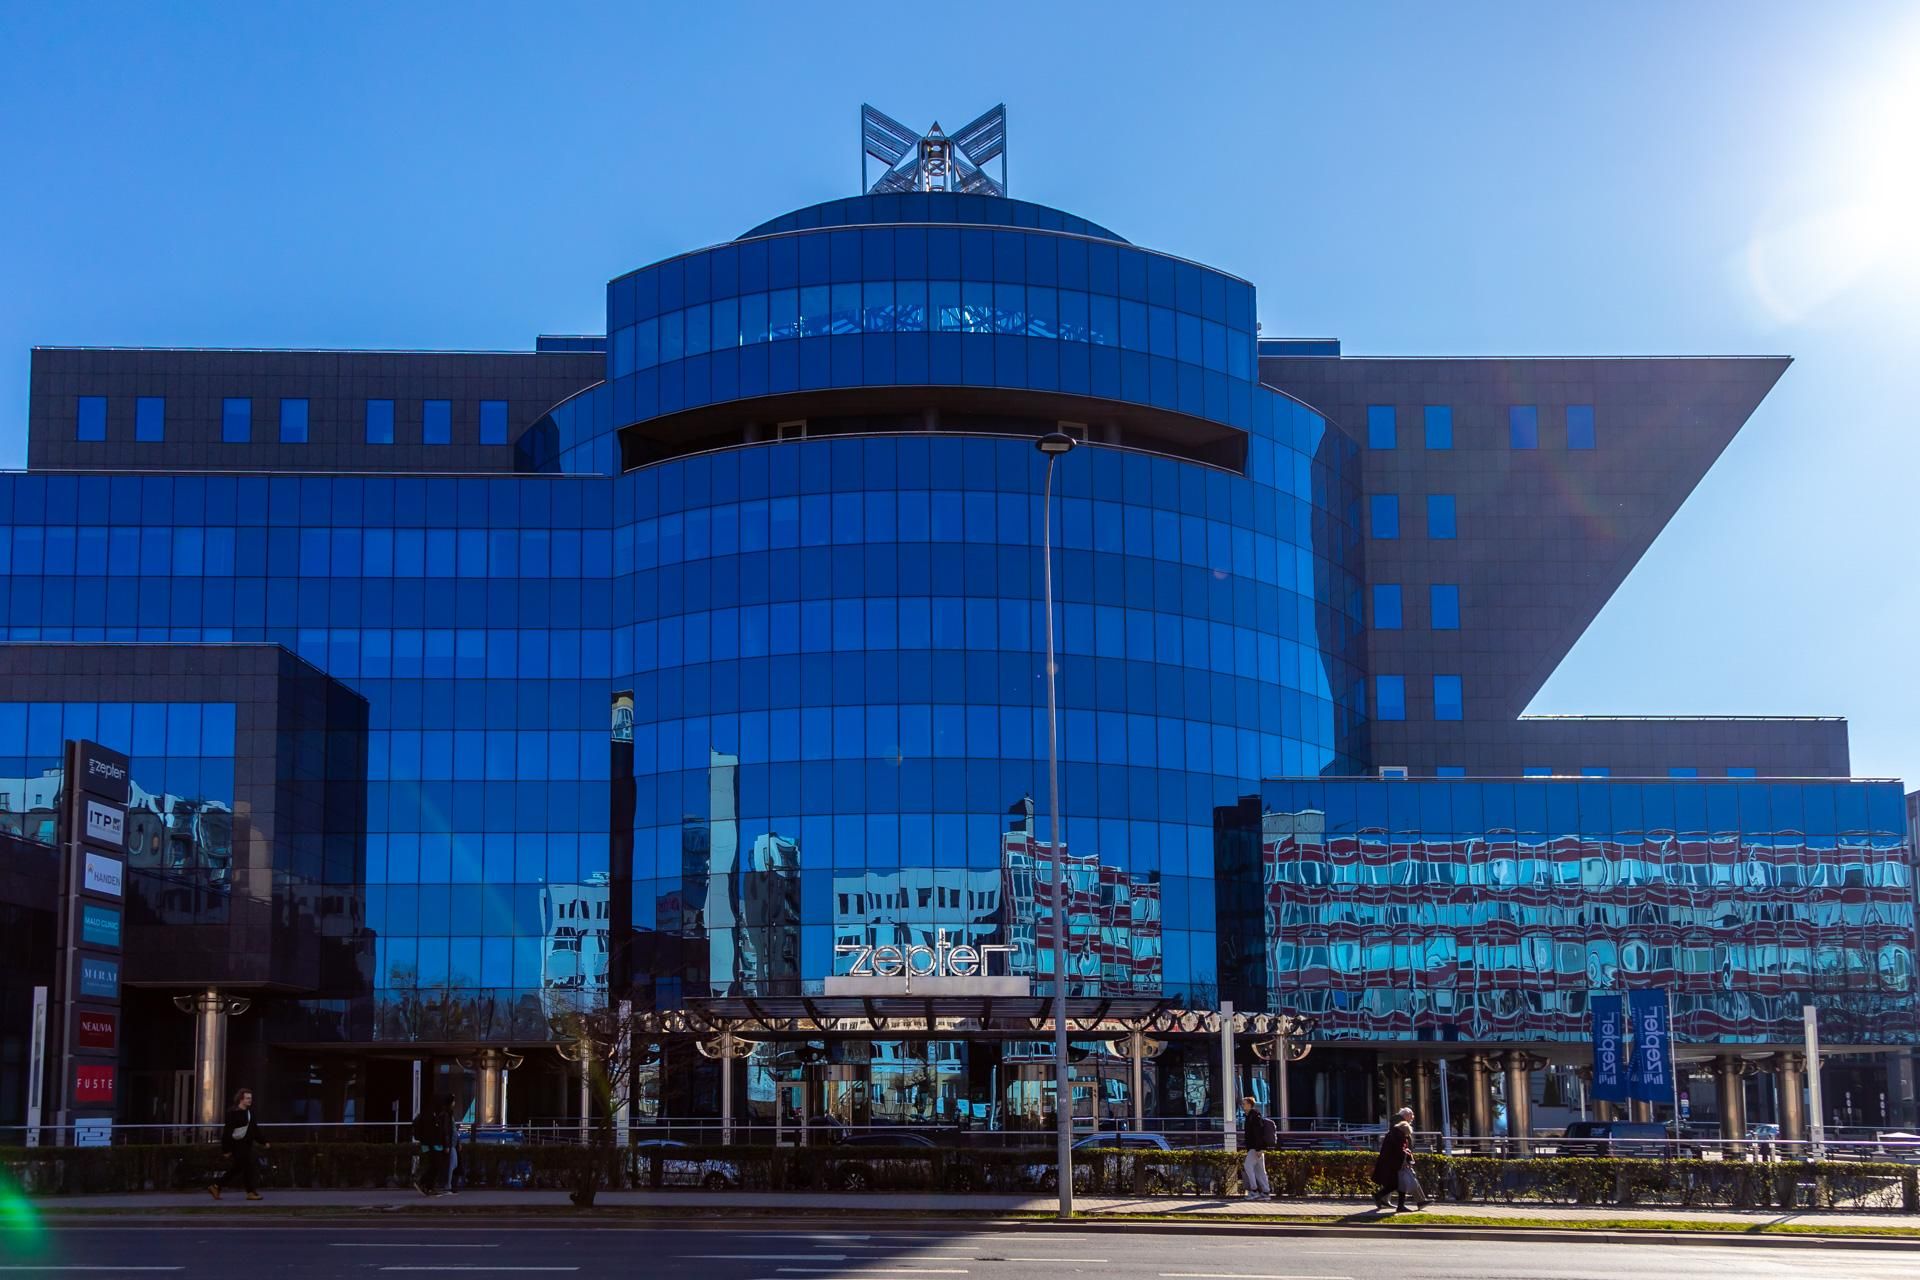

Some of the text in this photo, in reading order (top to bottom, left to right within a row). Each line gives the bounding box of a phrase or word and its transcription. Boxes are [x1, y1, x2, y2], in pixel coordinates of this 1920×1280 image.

[94, 759, 126, 779] zepter
[90, 810, 112, 827] ITP
[94, 871, 121, 887] HANDEN
[835, 927, 1018, 995] zepter
[84, 967, 117, 982] MIRAI
[76, 1078, 113, 1089] FUSTE
